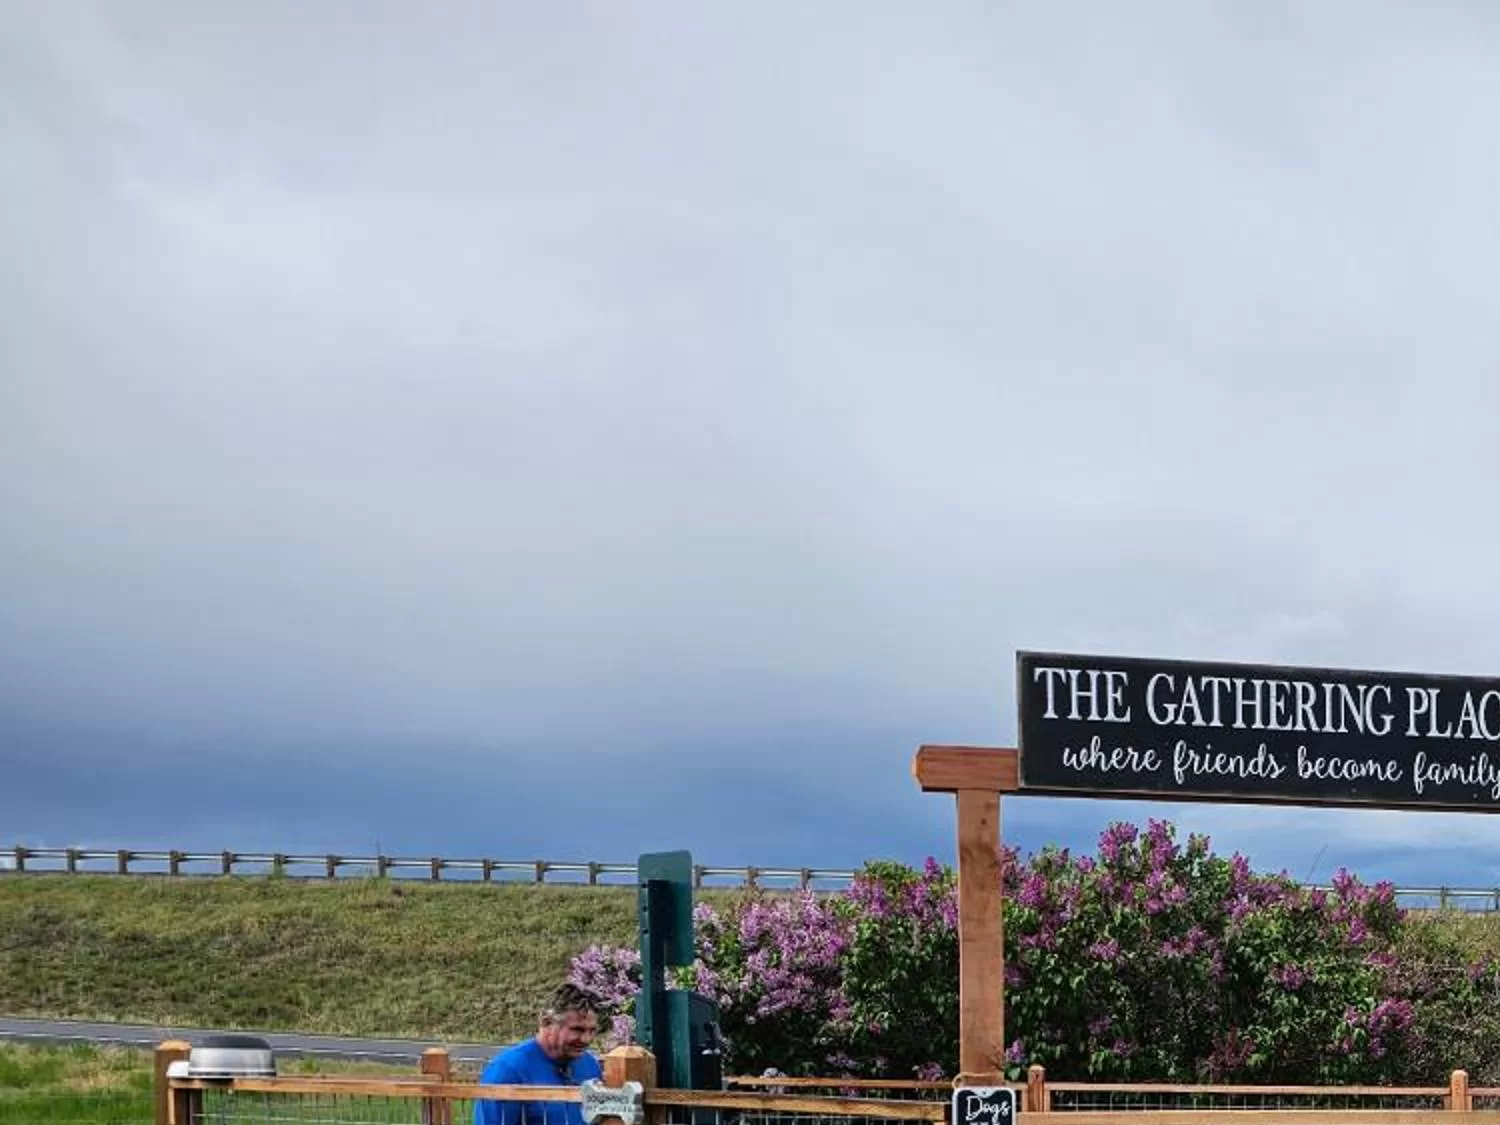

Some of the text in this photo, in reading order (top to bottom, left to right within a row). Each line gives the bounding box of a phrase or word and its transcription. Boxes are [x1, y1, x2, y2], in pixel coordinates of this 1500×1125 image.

[1033, 666, 1132, 724] THE
[1145, 672, 1395, 736] GATHERING
[1063, 735, 1162, 773] where
[1173, 739, 1286, 784] friends
[1297, 745, 1402, 784] become
[965, 1095, 1010, 1123] Dogs
